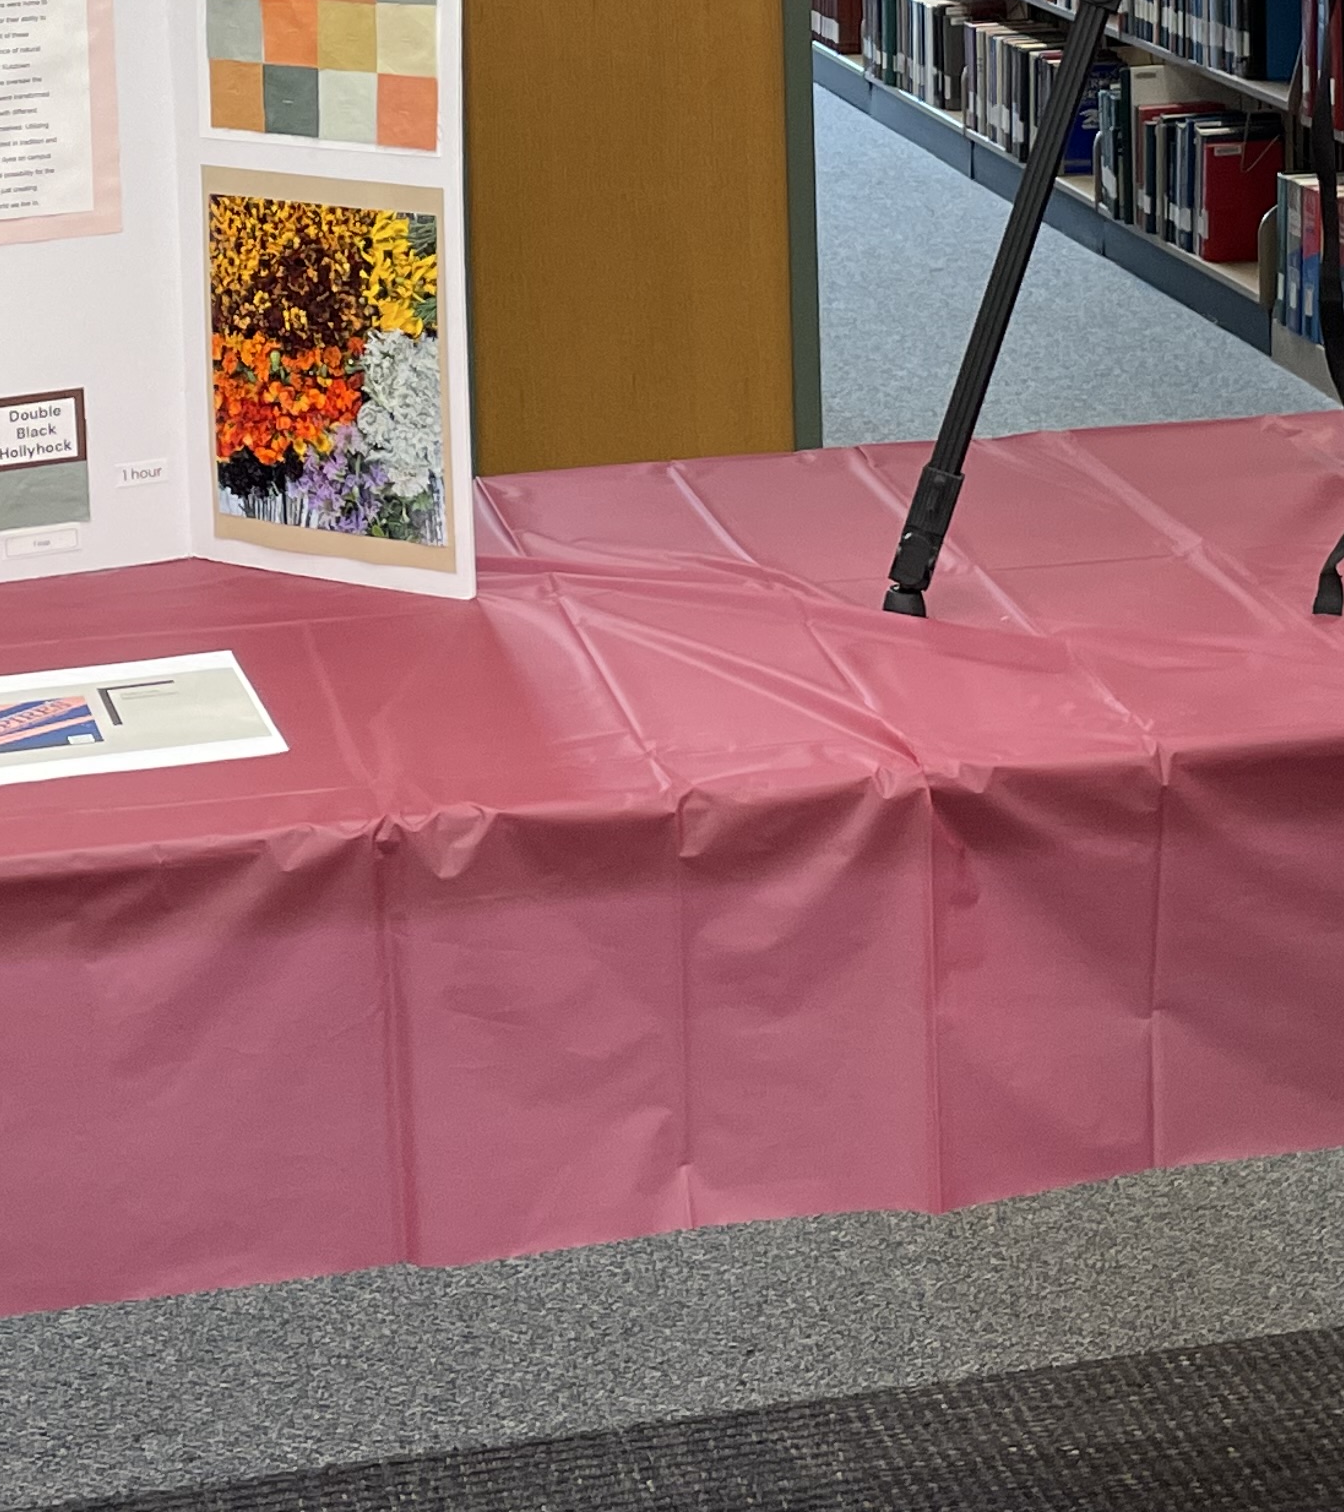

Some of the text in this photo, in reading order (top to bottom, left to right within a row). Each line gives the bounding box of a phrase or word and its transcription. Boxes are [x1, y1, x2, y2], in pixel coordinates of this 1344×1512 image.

[9, 406, 61, 422] Double
[17, 424, 56, 439] Black
[0, 439, 72, 459] Hollyhock
[122, 466, 162, 481] 1 hour
